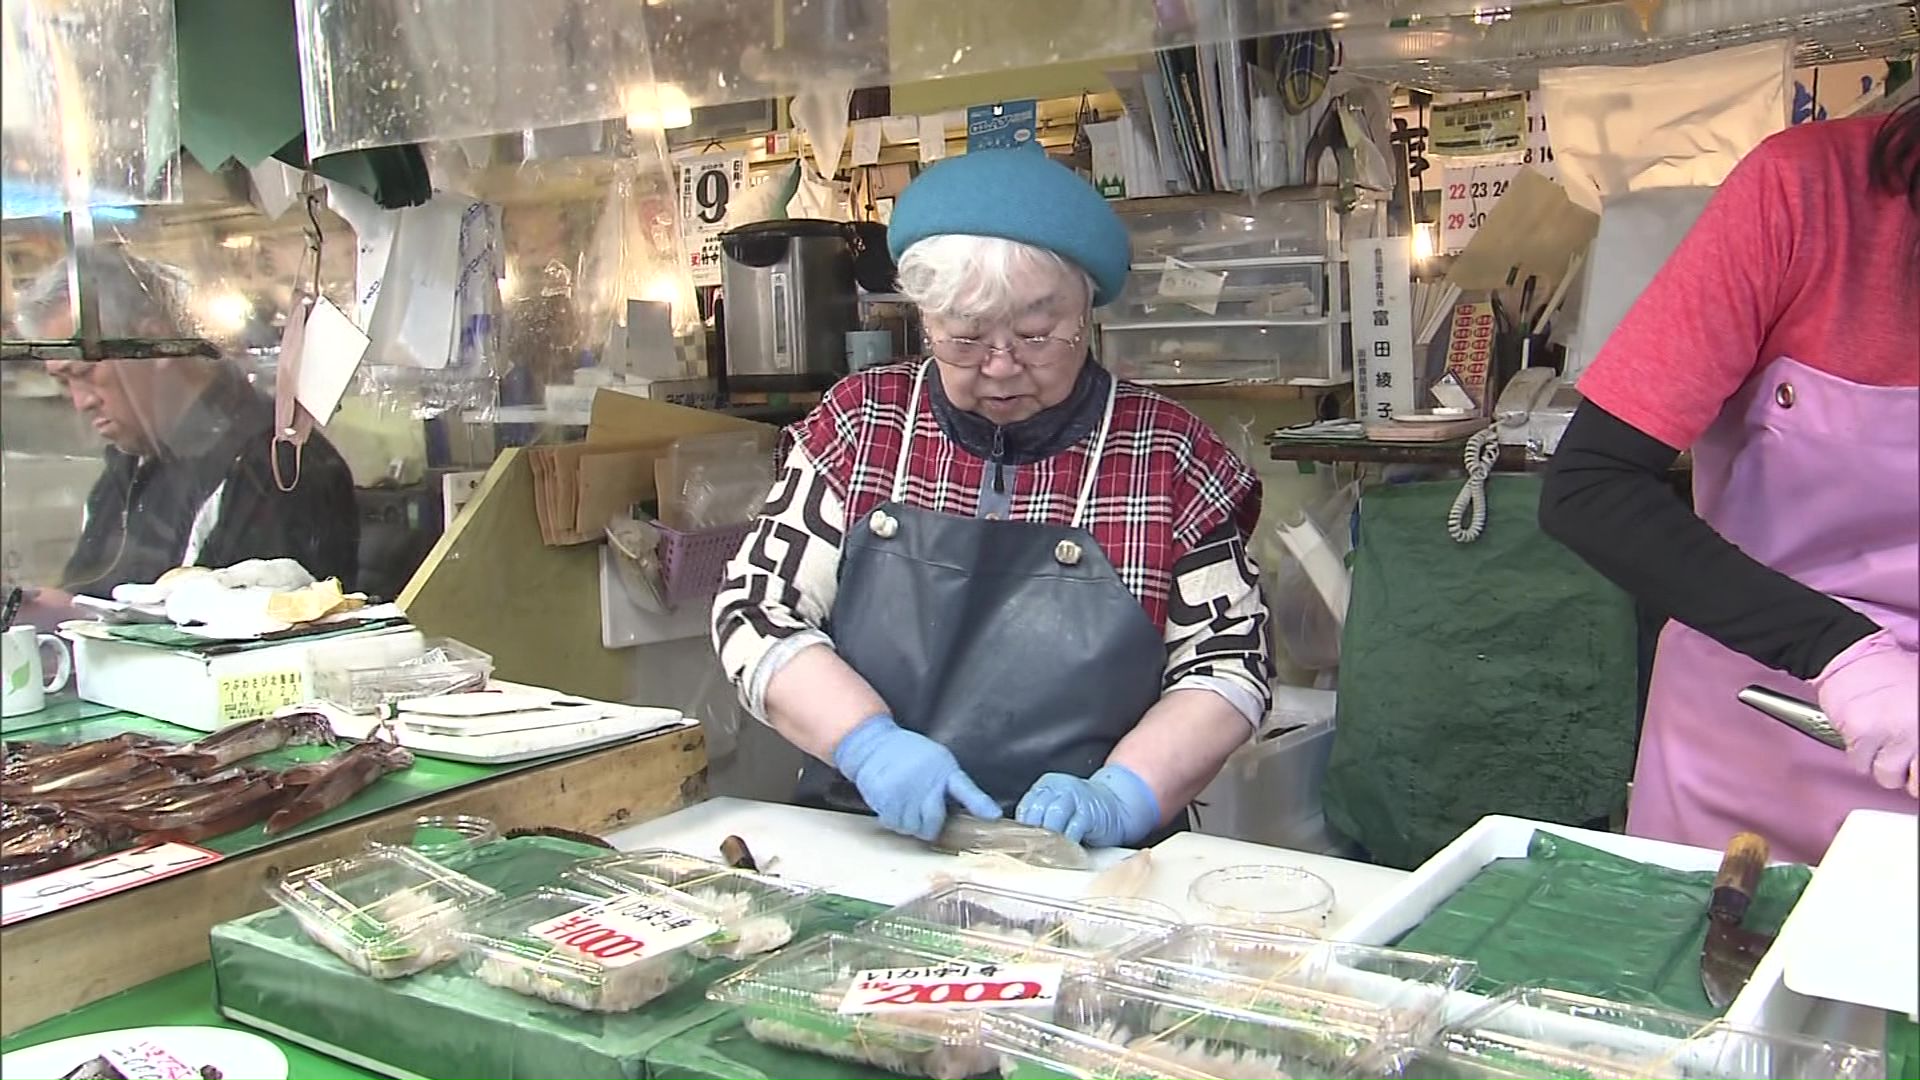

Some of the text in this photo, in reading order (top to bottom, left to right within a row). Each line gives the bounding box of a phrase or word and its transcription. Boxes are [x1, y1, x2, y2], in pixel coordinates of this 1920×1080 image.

[696, 170, 729, 223] 9
[1449, 184, 1467, 200] 22
[1470, 183, 1488, 198] 23
[1447, 213, 1465, 230] 29
[1372, 309, 1393, 419] 富田綾子
